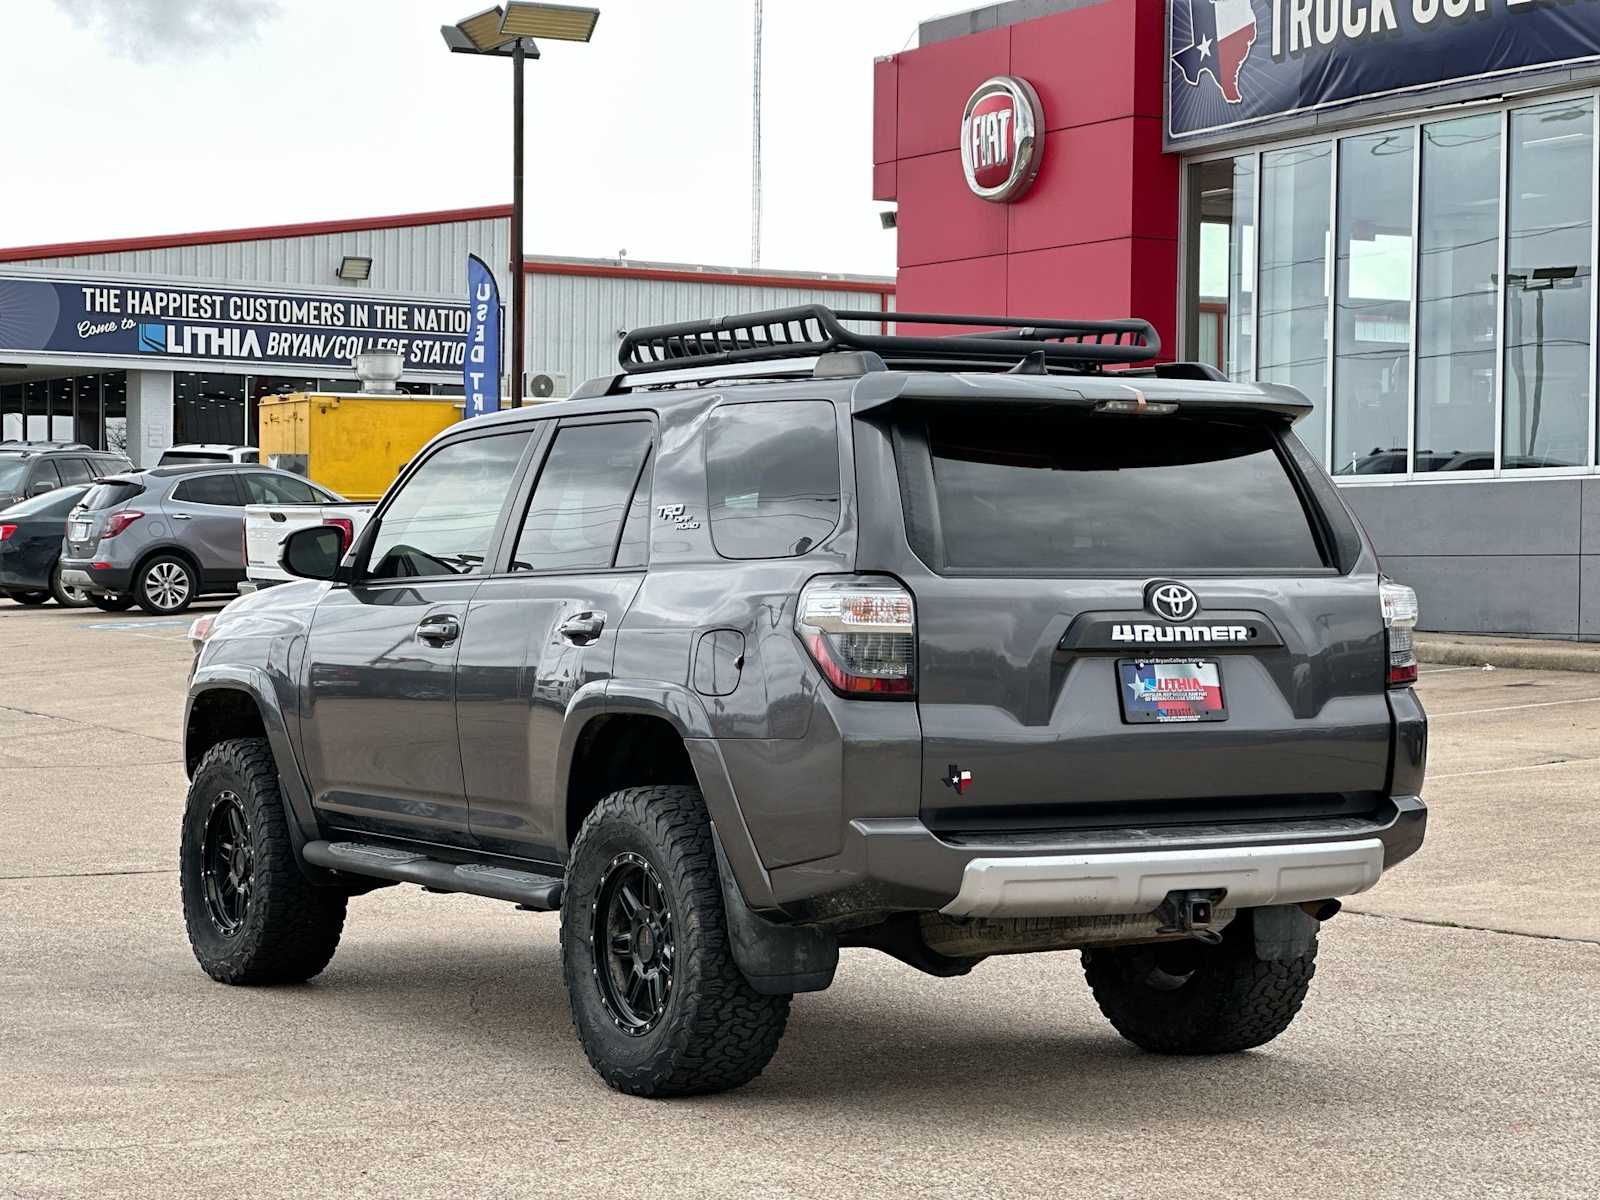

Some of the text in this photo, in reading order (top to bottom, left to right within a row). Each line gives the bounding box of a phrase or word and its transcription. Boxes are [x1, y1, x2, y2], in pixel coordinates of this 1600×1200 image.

[972, 108, 1012, 169] FIAT
[82, 287, 121, 313] THE
[127, 290, 224, 319] HAPPIEST
[229, 297, 345, 327] CUSTOMERS
[350, 304, 369, 327] IN
[374, 305, 408, 330] THE
[77, 317, 136, 338] Come to
[167, 324, 263, 358] LITHIA
[410, 340, 466, 365] STATIO
[657, 504, 685, 520] TRD
[1111, 624, 1248, 642] 4RUNNER
